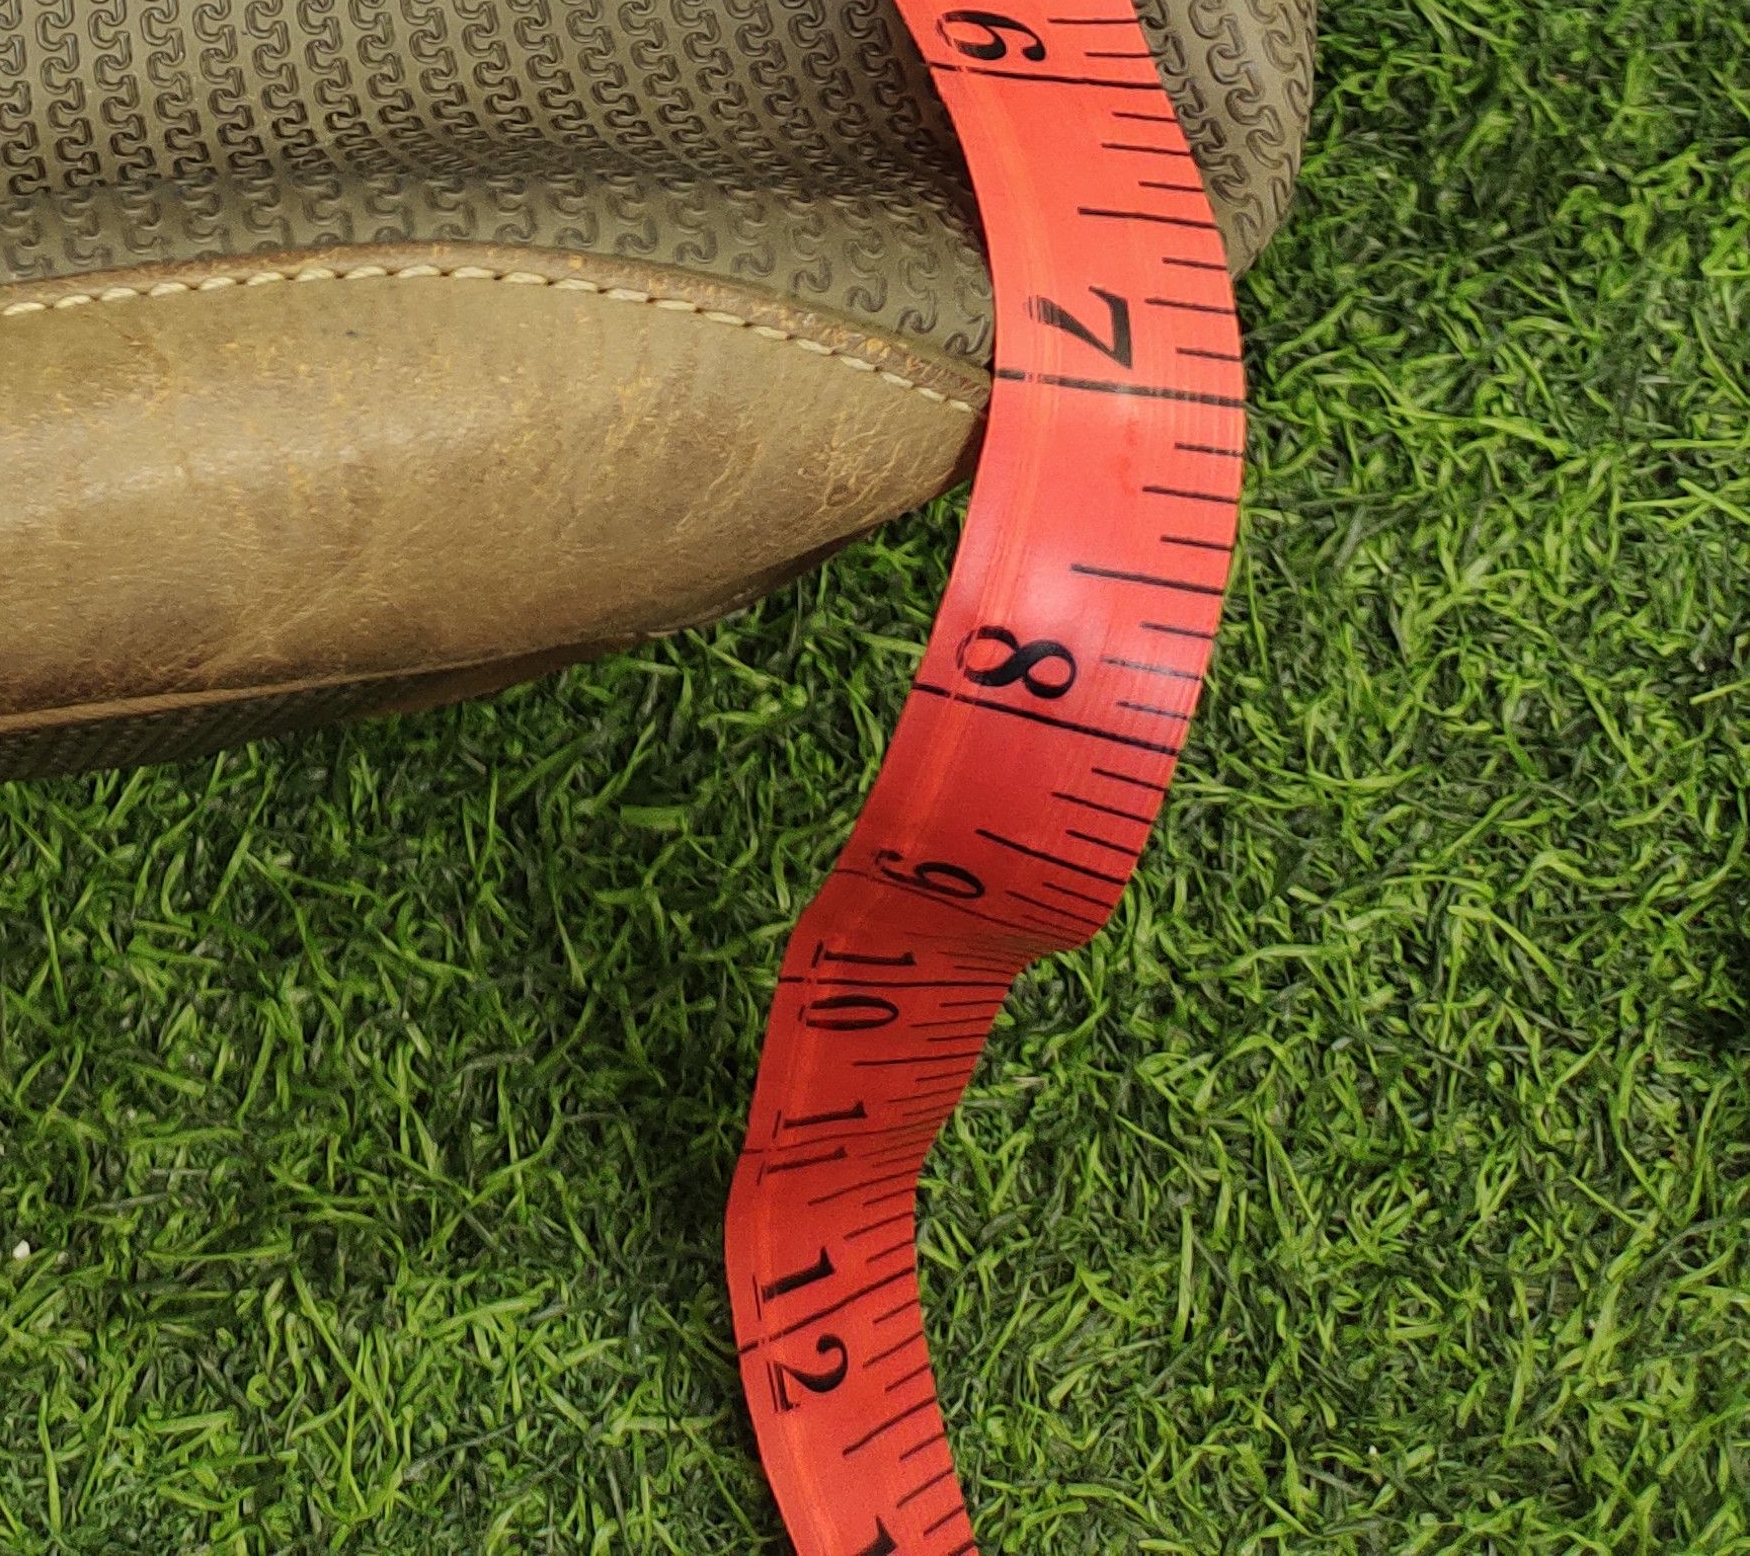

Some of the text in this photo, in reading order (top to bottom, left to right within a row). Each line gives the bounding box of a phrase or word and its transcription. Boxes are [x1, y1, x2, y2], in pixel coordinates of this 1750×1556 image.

[936, 8, 1047, 63] 6
[1025, 284, 1133, 371] 7
[956, 624, 1078, 700] 8
[875, 847, 985, 901] 9
[797, 939, 918, 1032] 10
[756, 1100, 869, 1187] 11
[752, 1245, 849, 1415] 12
